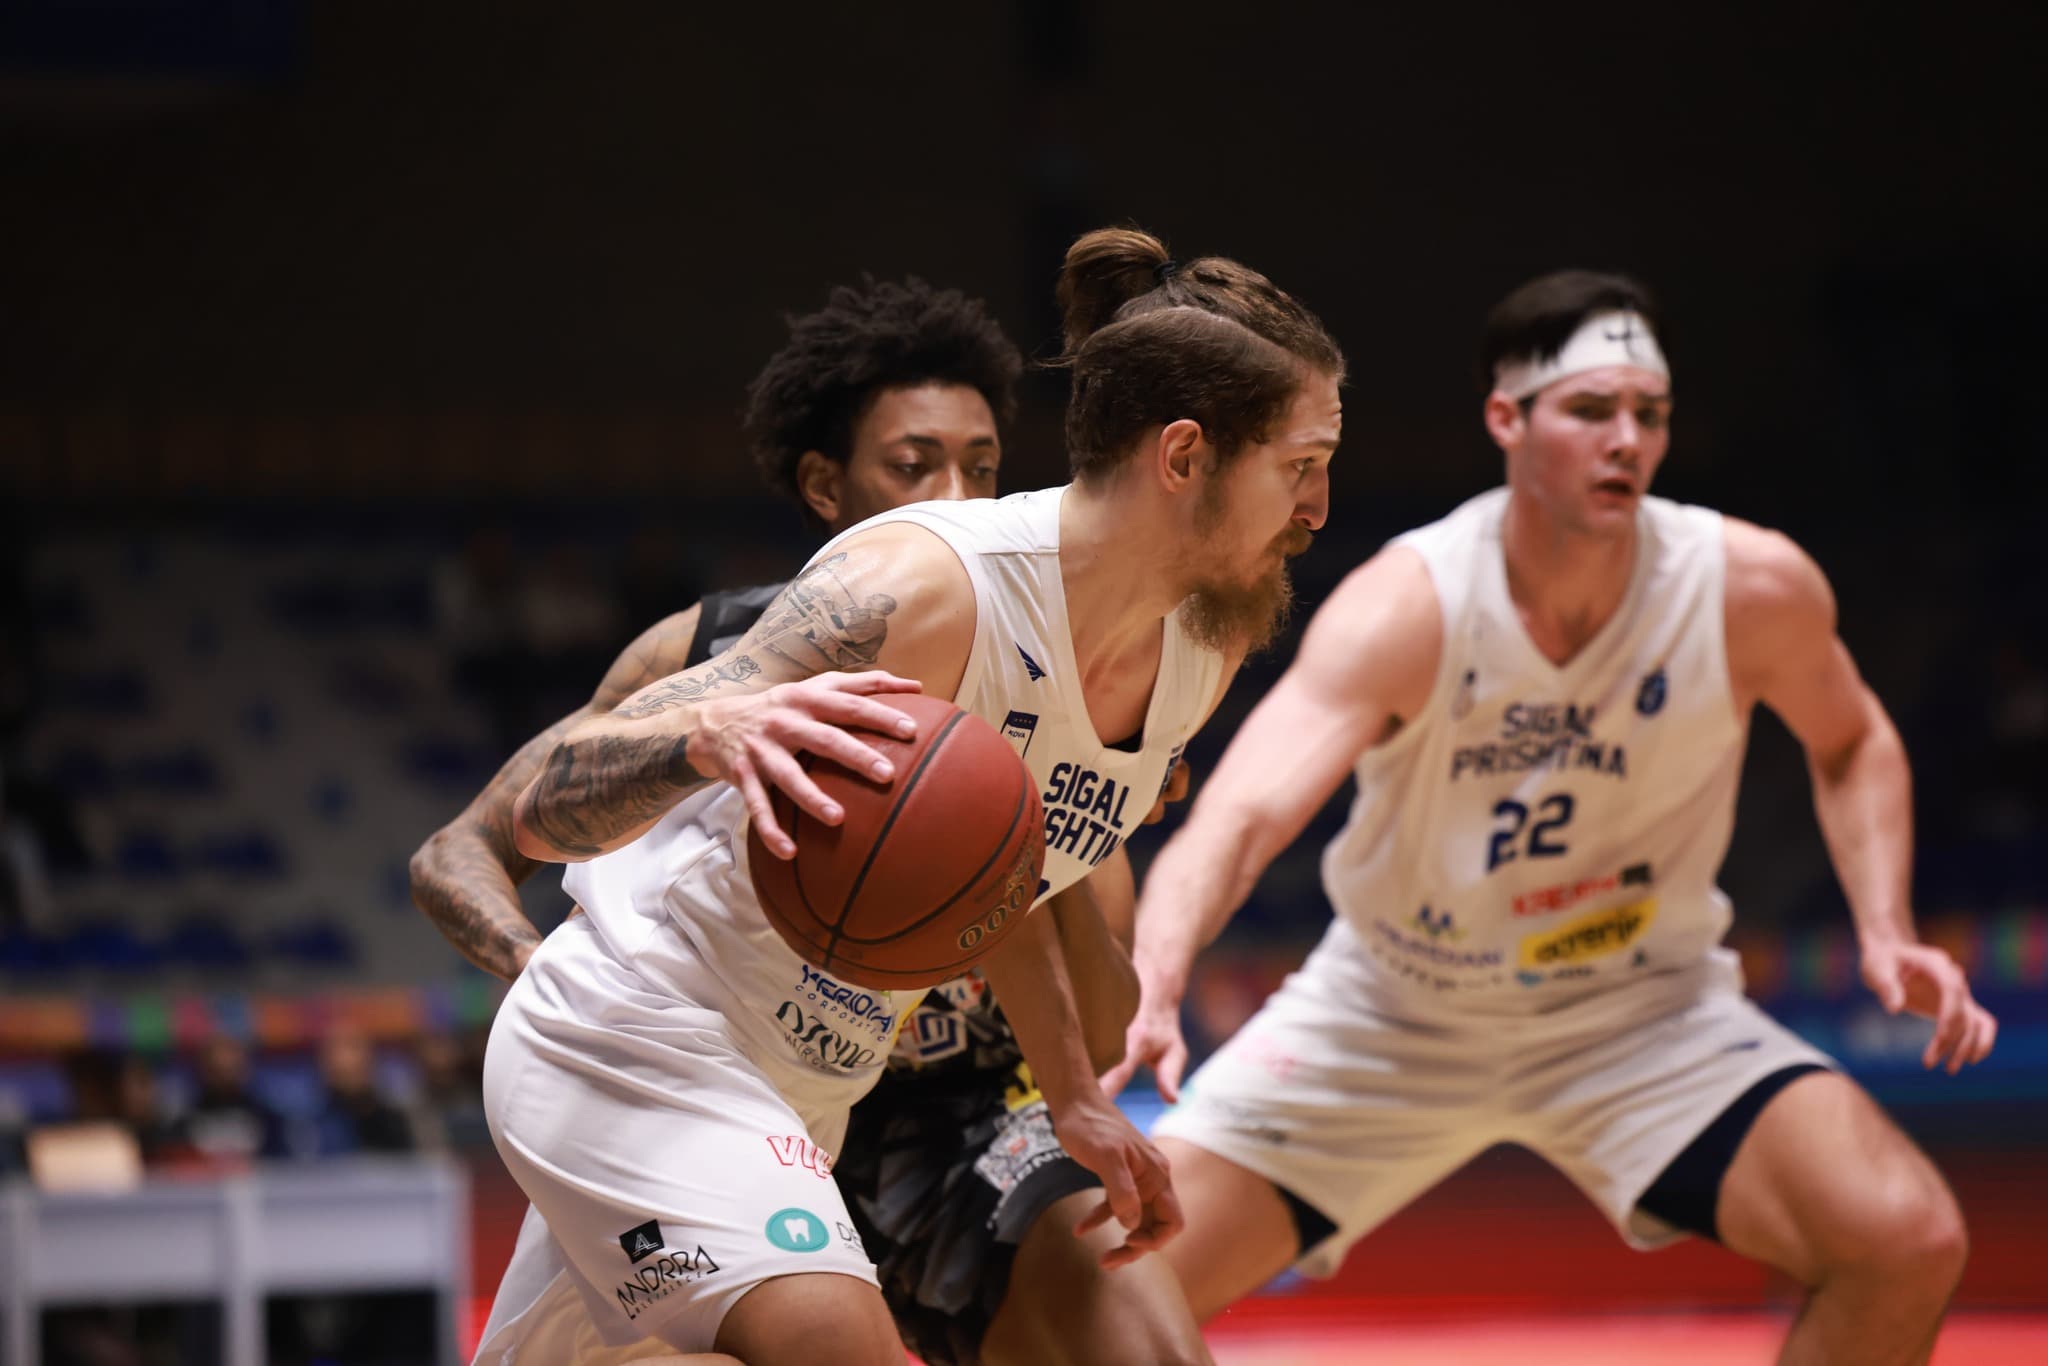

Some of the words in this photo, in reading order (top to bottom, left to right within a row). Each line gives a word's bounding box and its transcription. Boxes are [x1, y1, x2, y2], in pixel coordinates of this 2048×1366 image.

[1043, 762, 1130, 830] SIGAL
[1043, 807, 1124, 868] SHTIN
[1485, 793, 1575, 874] 22
